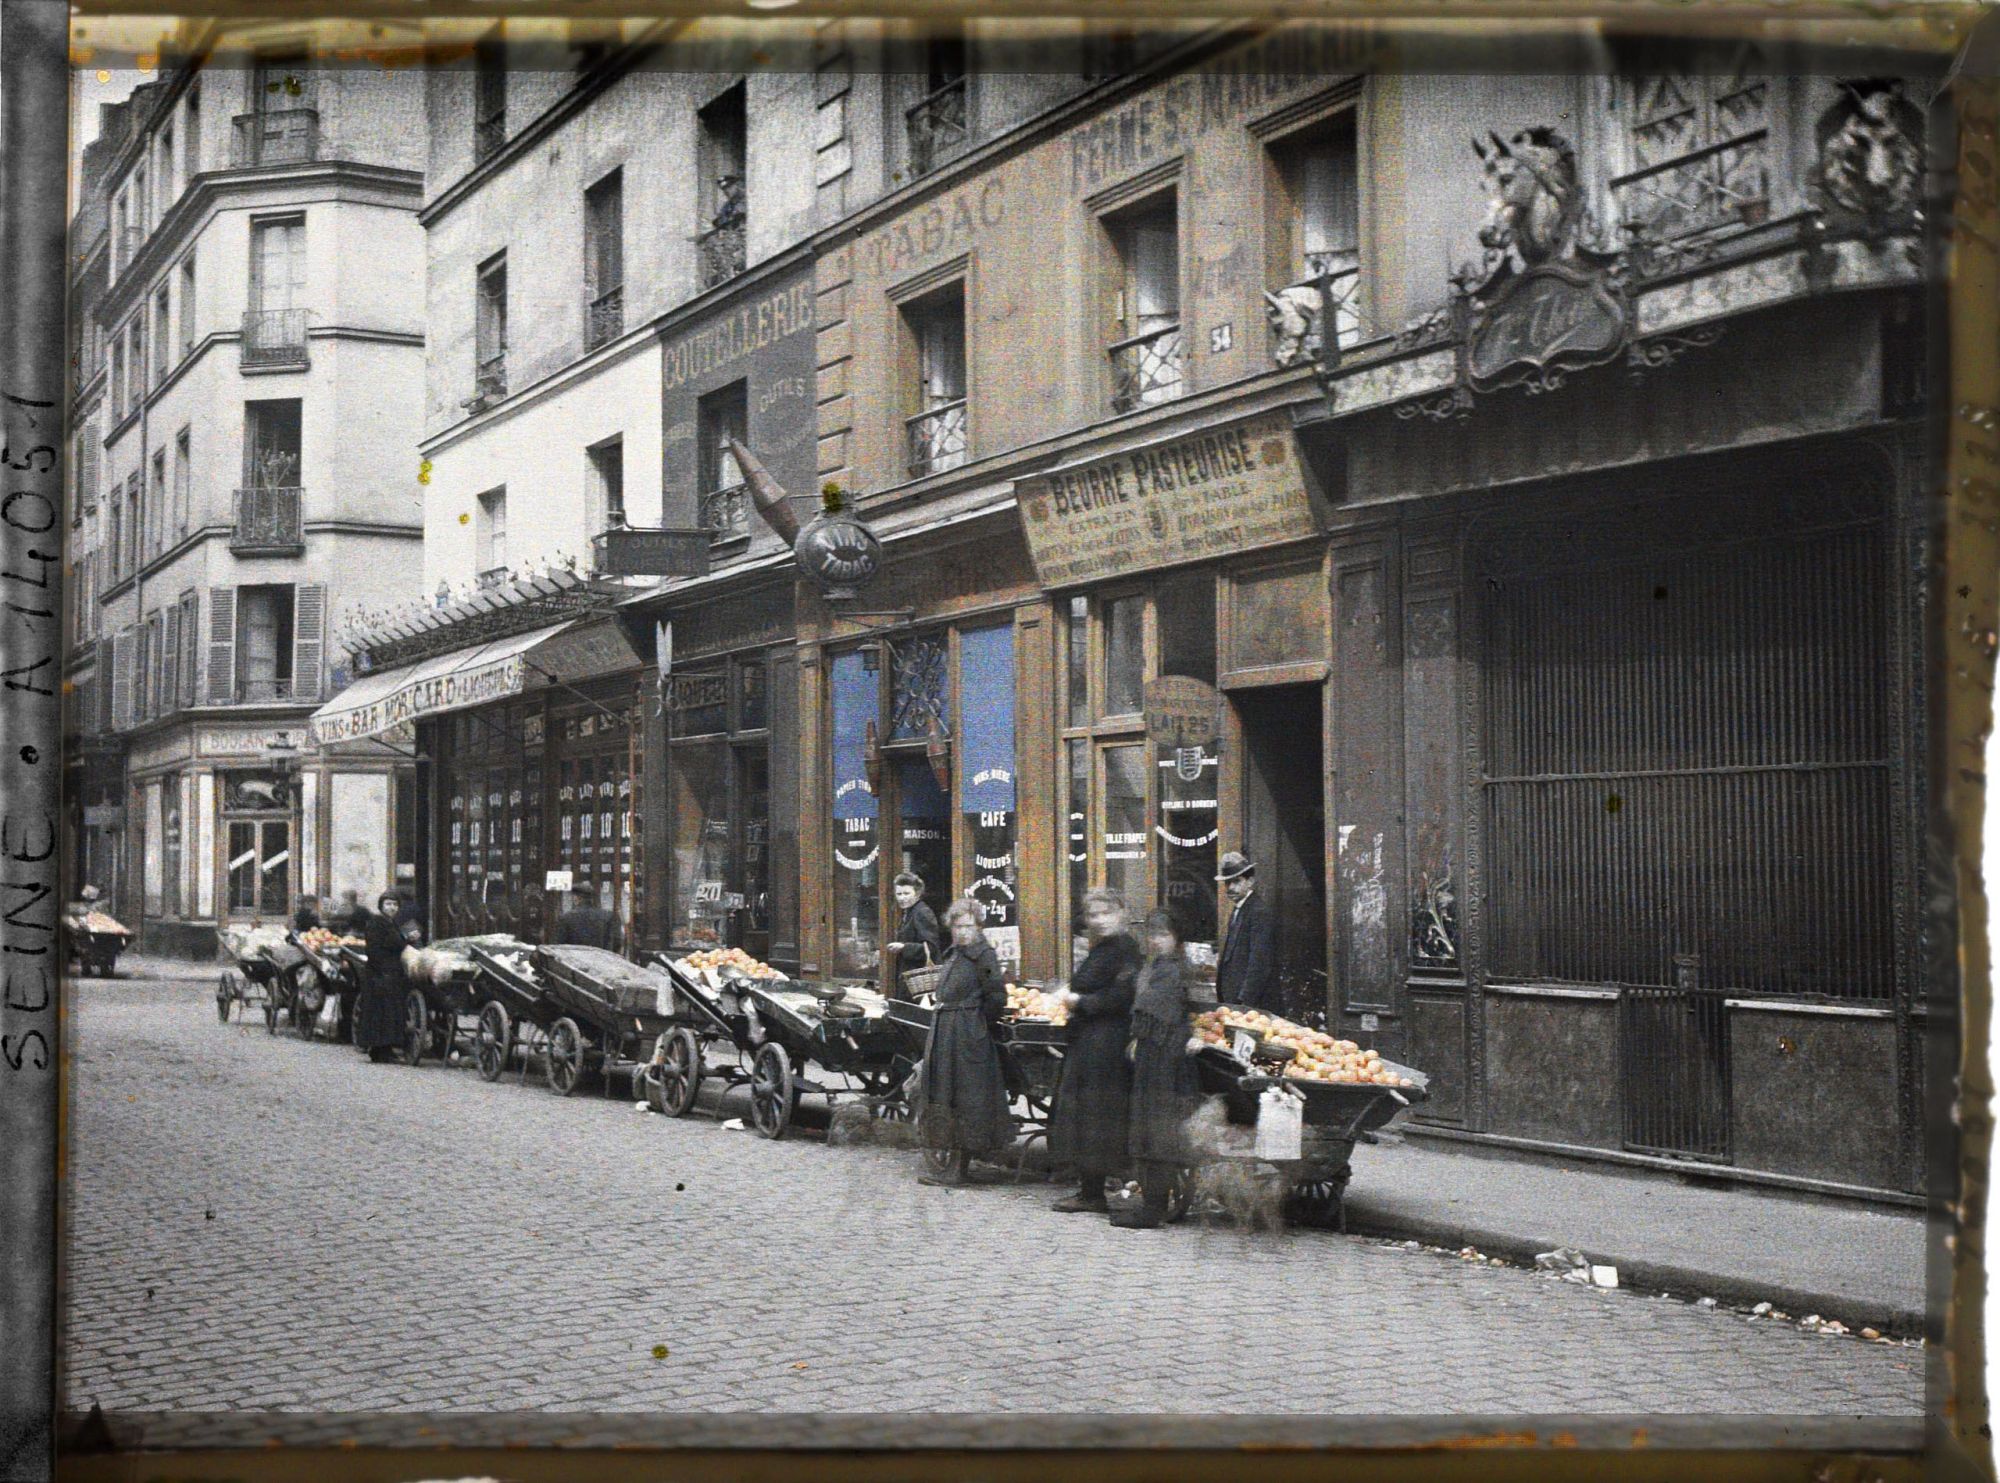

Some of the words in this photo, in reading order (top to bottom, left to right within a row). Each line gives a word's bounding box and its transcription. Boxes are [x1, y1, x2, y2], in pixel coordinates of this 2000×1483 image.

[663, 280, 813, 390] COUTELLERIE
[1051, 461, 1129, 518] BEURRE
[1203, 481, 1252, 502] TABLE
[1068, 513, 1112, 536] EXTRA
[321, 718, 345, 742] VINS
[352, 705, 378, 736] BAR
[844, 817, 871, 833] TABAC
[980, 804, 1007, 828] CAFÉ
[903, 829, 940, 840] MAISON
[975, 853, 1012, 870] LIQUEURS
[697, 886, 719, 903] 20
